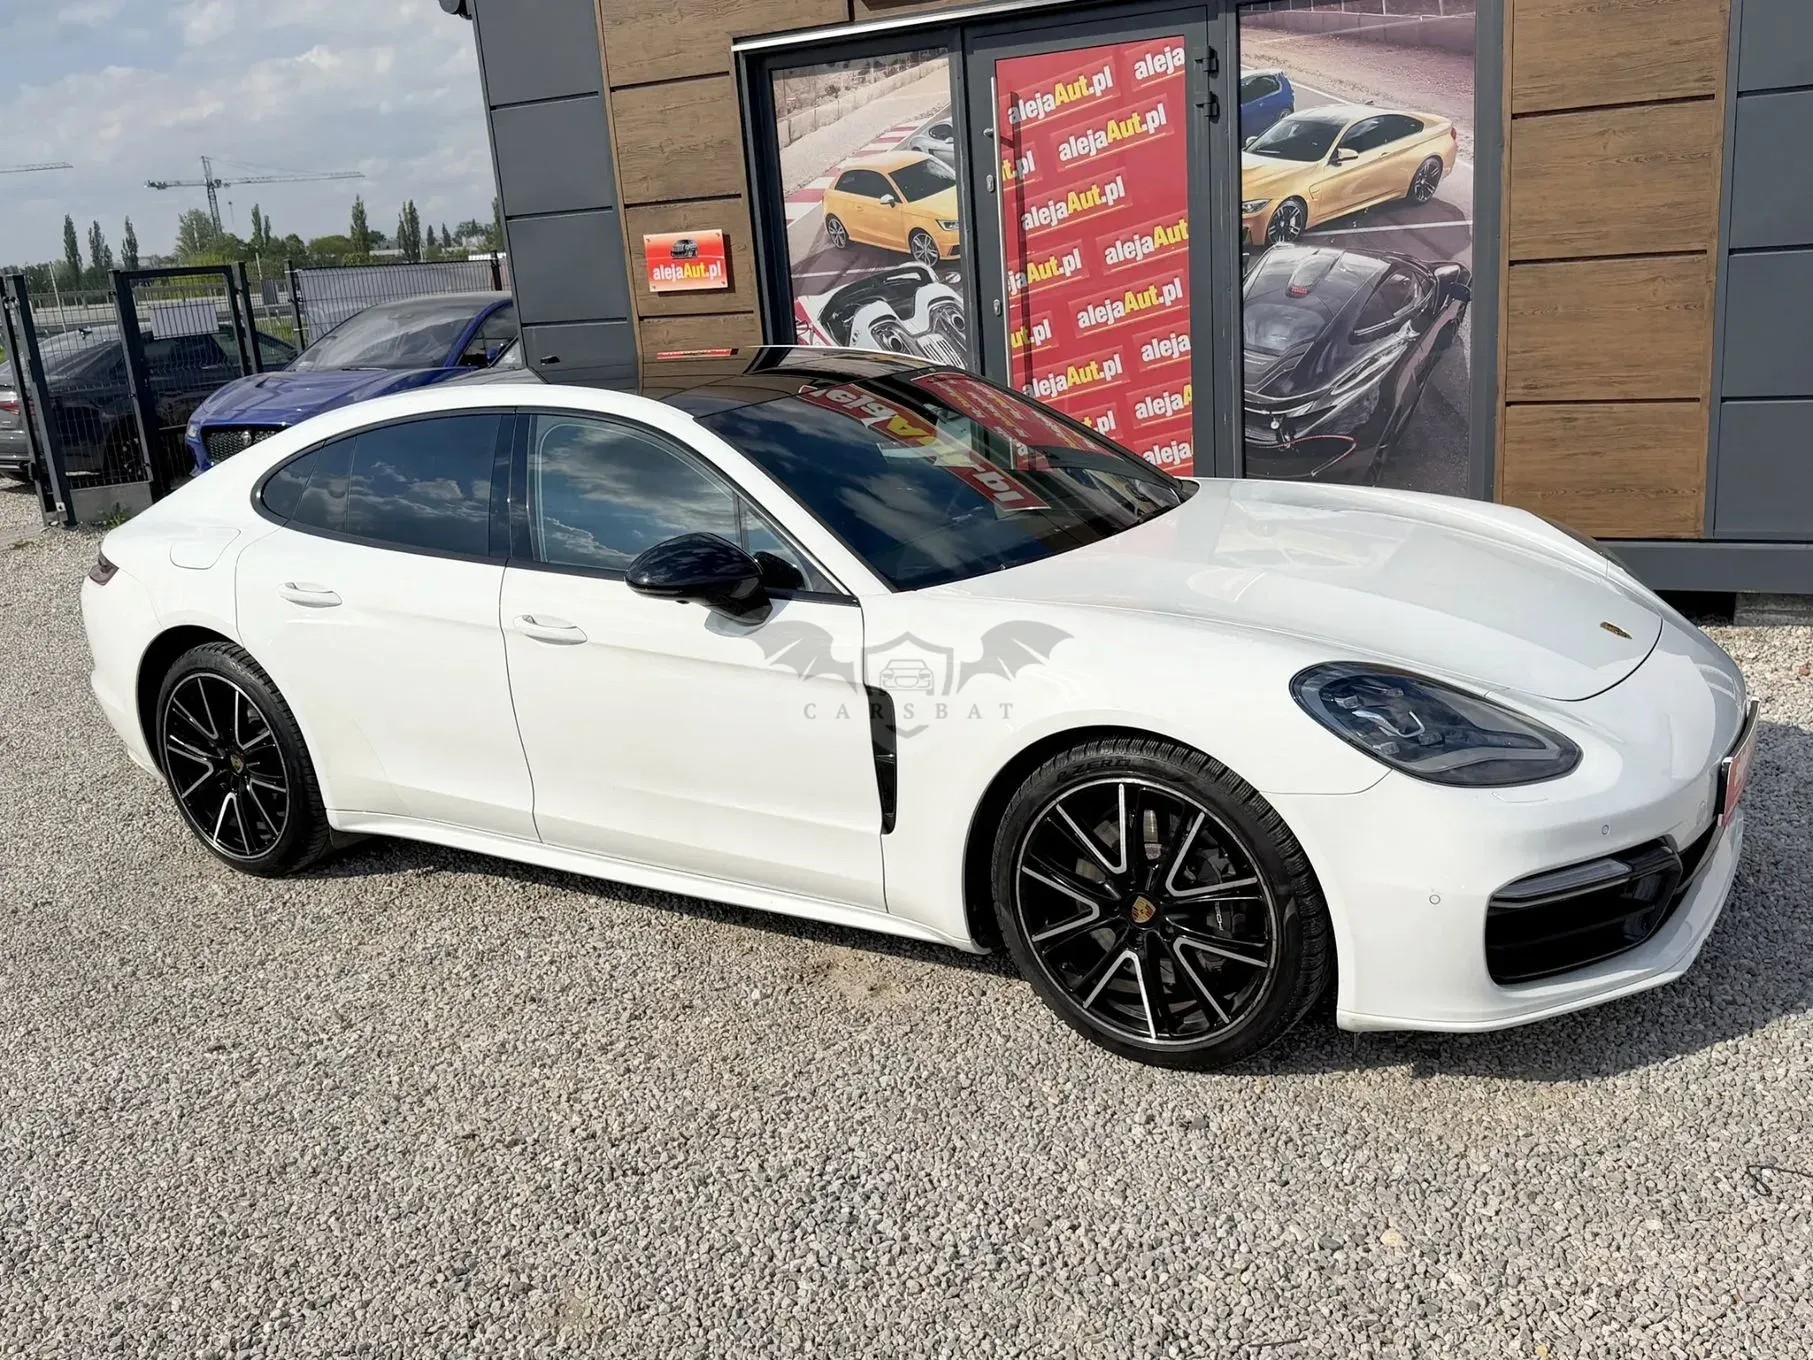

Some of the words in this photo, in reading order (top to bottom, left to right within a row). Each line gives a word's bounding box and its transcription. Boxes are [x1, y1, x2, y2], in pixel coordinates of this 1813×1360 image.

[1134, 46, 1185, 80] aleja
[1008, 65, 1114, 125] alejaAut.pl
[1058, 103, 1167, 162] alejaAut.pl
[1002, 150, 1036, 181] t.pl
[1021, 176, 1126, 231] alejaAut.pl
[1104, 218, 1189, 266] alejaAut
[652, 260, 722, 281] alejaAut.pl
[1077, 277, 1184, 329] alejaAut.pl
[1141, 332, 1192, 362] aleja
[1022, 353, 1124, 399] alejaAut.pl
[1142, 440, 1193, 466] aleja
